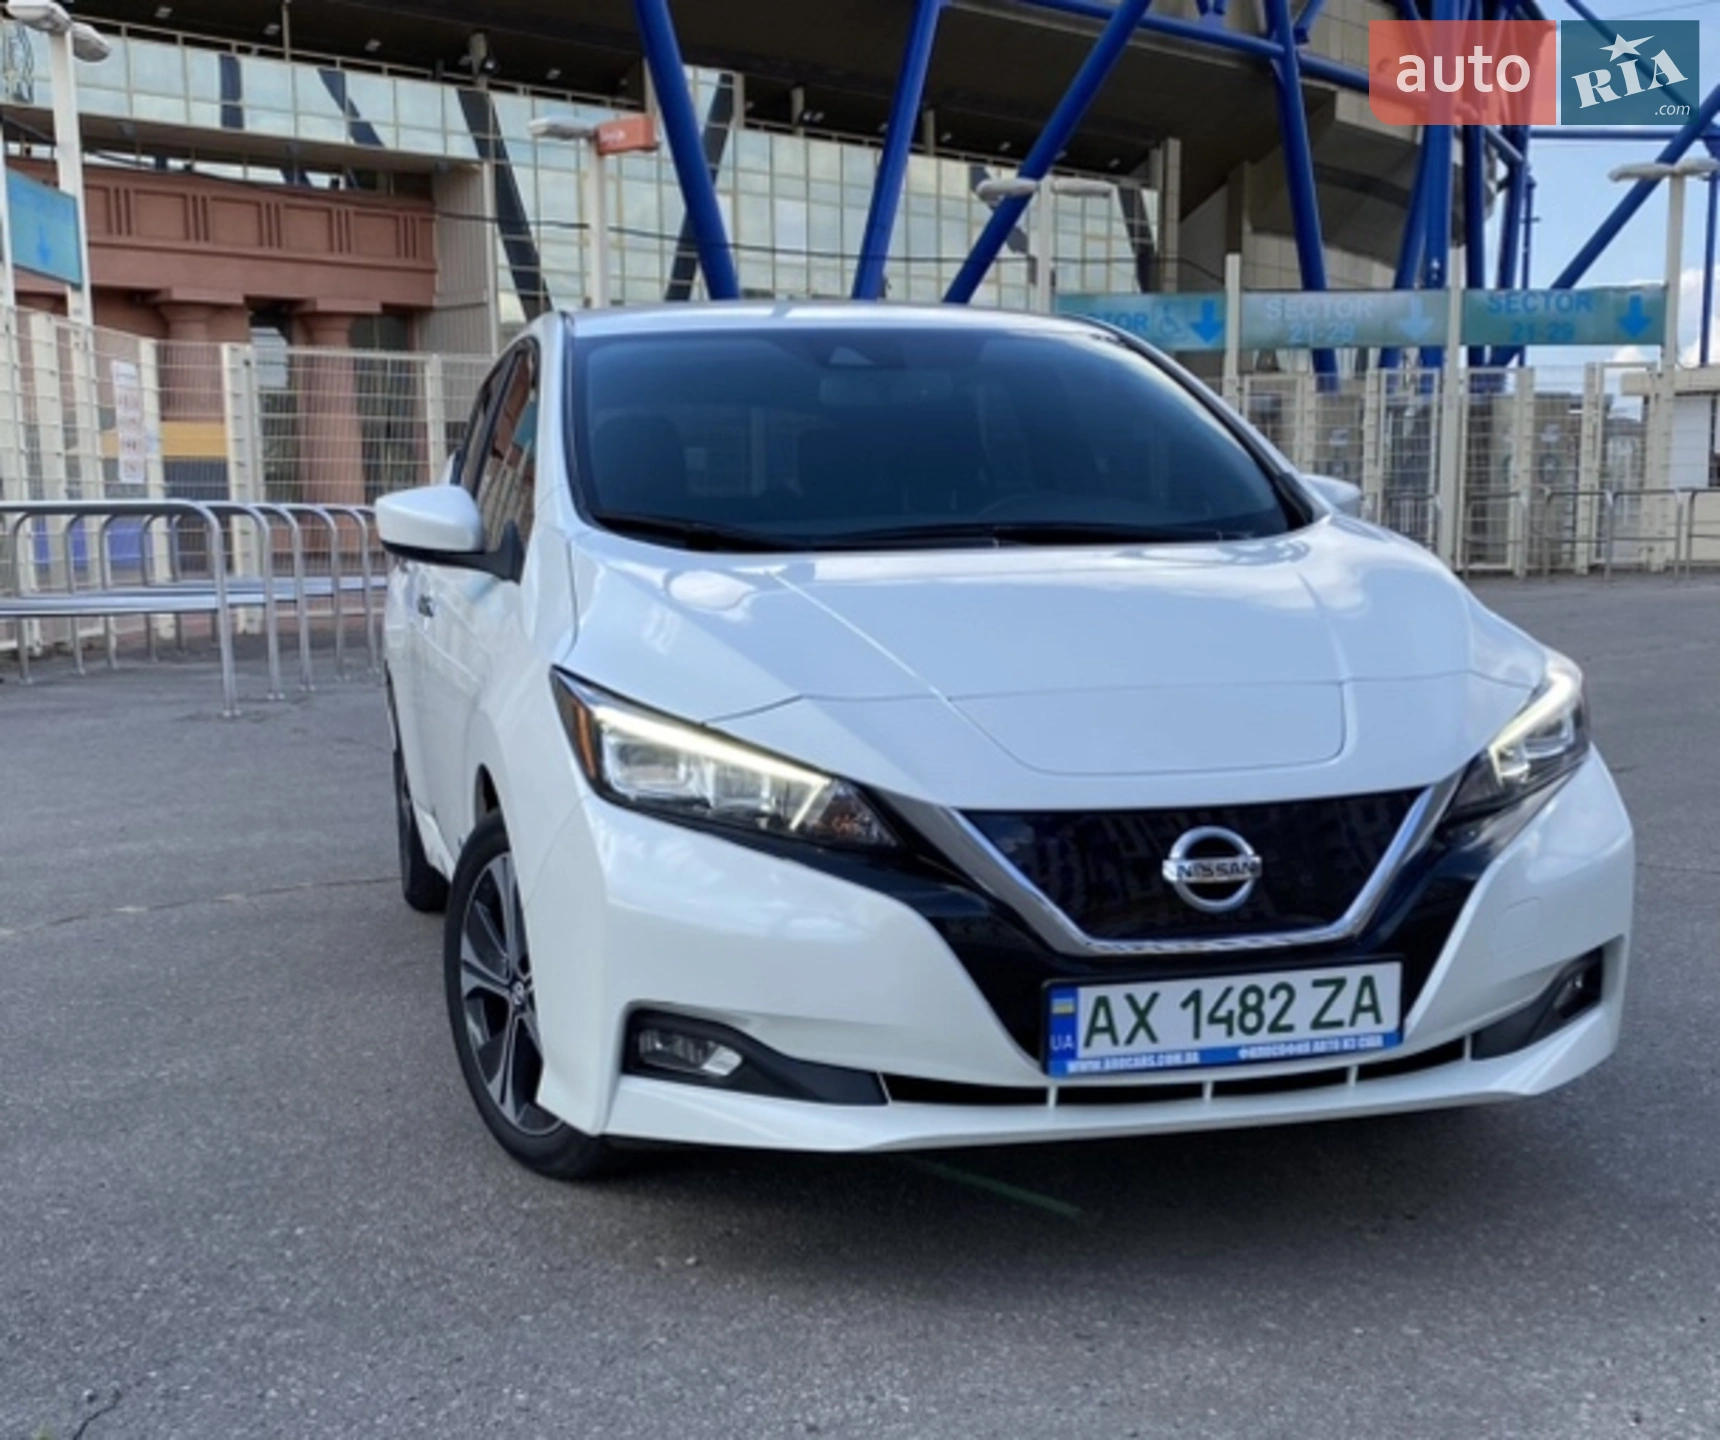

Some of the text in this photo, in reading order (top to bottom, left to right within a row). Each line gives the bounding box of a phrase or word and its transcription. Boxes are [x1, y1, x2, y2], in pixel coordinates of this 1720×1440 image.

[1266, 297, 1374, 320] SECTOR
[1487, 291, 1593, 314] SECTOR
[1177, 861, 1256, 879] NISSAN
[1083, 974, 1383, 1049] AX 1482 ZA
[1051, 1035, 1075, 1051] UA
